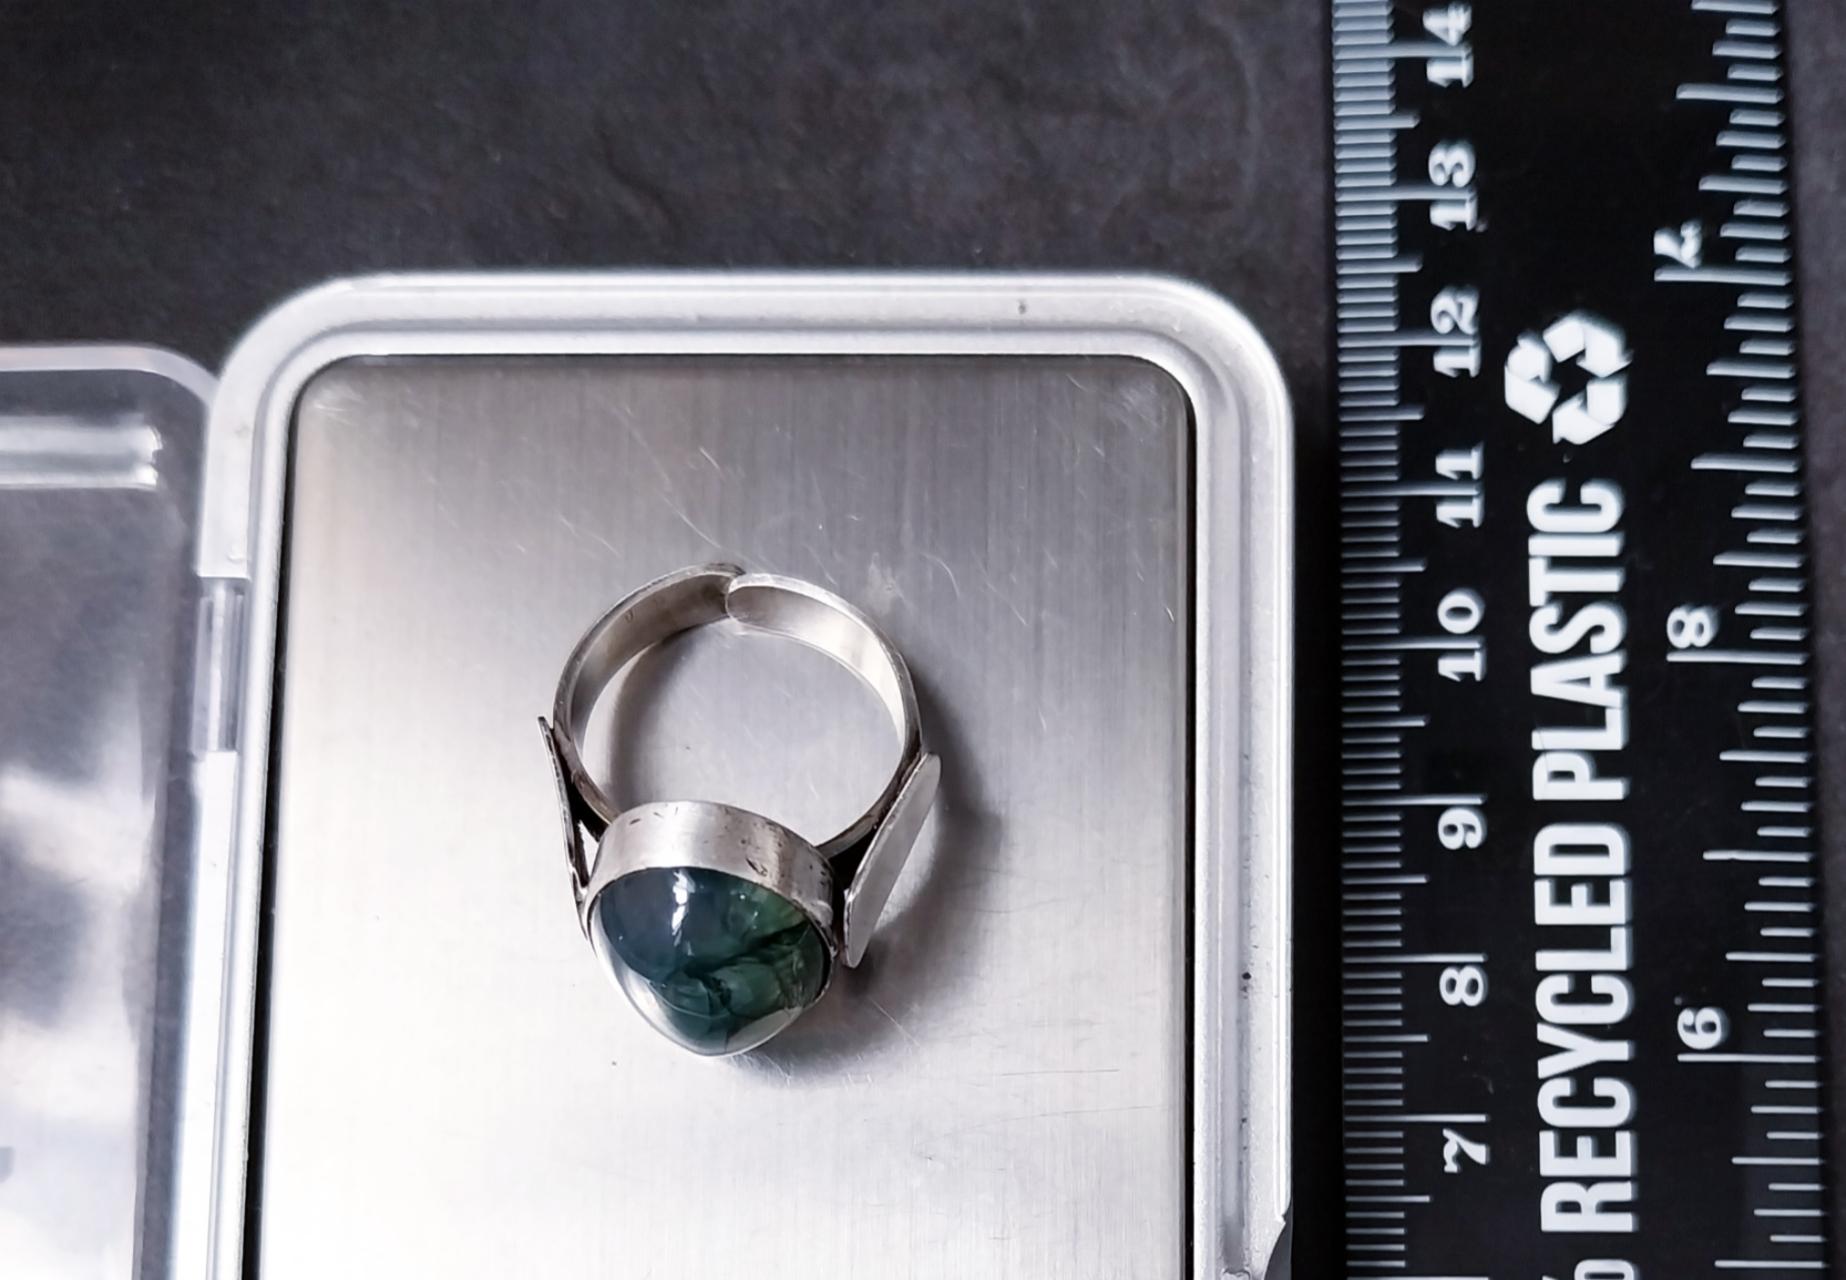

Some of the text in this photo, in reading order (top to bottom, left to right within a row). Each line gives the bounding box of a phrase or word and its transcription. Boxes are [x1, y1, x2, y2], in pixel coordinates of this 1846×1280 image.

[1422, 2, 1474, 88] 14
[1428, 140, 1478, 230] 13
[1653, 220, 1702, 268] 7
[1430, 285, 1480, 378] 12
[1435, 441, 1483, 528] 11
[1437, 588, 1484, 682] 10
[1526, 479, 1628, 800] PLASTIC
[1666, 606, 1718, 649] 8
[1437, 807, 1486, 850] 9
[1439, 966, 1488, 1006] 8
[1533, 823, 1636, 1232] RECYCLED
[1677, 1007, 1727, 1050] 9
[1442, 1128, 1490, 1173] 7
